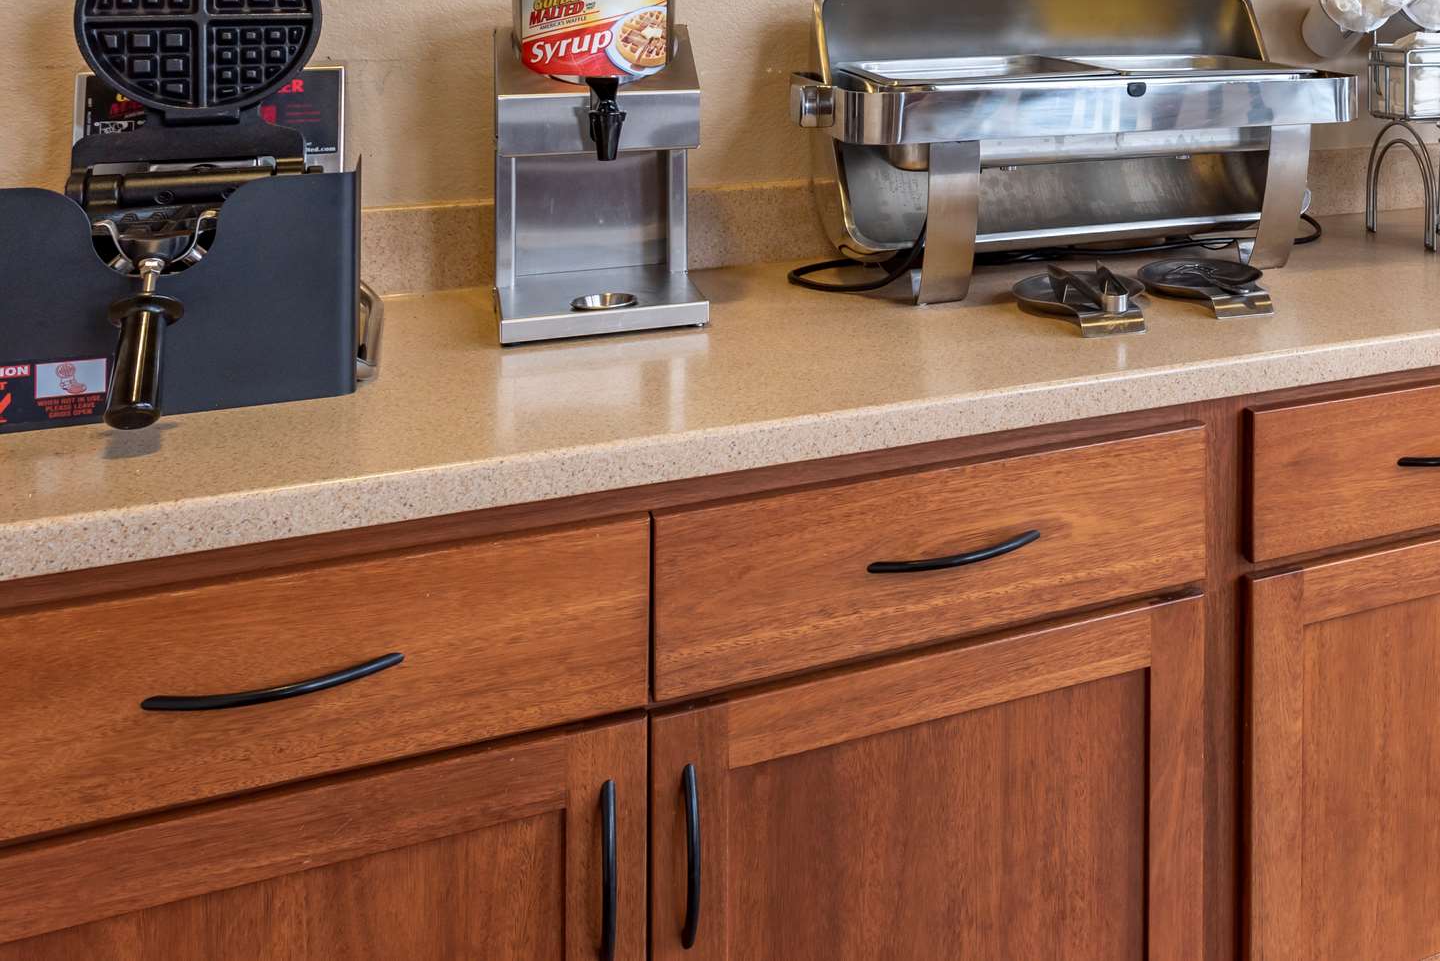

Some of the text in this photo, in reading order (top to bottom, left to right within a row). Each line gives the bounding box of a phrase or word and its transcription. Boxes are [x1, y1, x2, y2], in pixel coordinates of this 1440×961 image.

[529, 1, 584, 25] MALTED
[539, 16, 587, 30] AMERICA'S WAFFLE
[531, 29, 613, 64] Syrup
